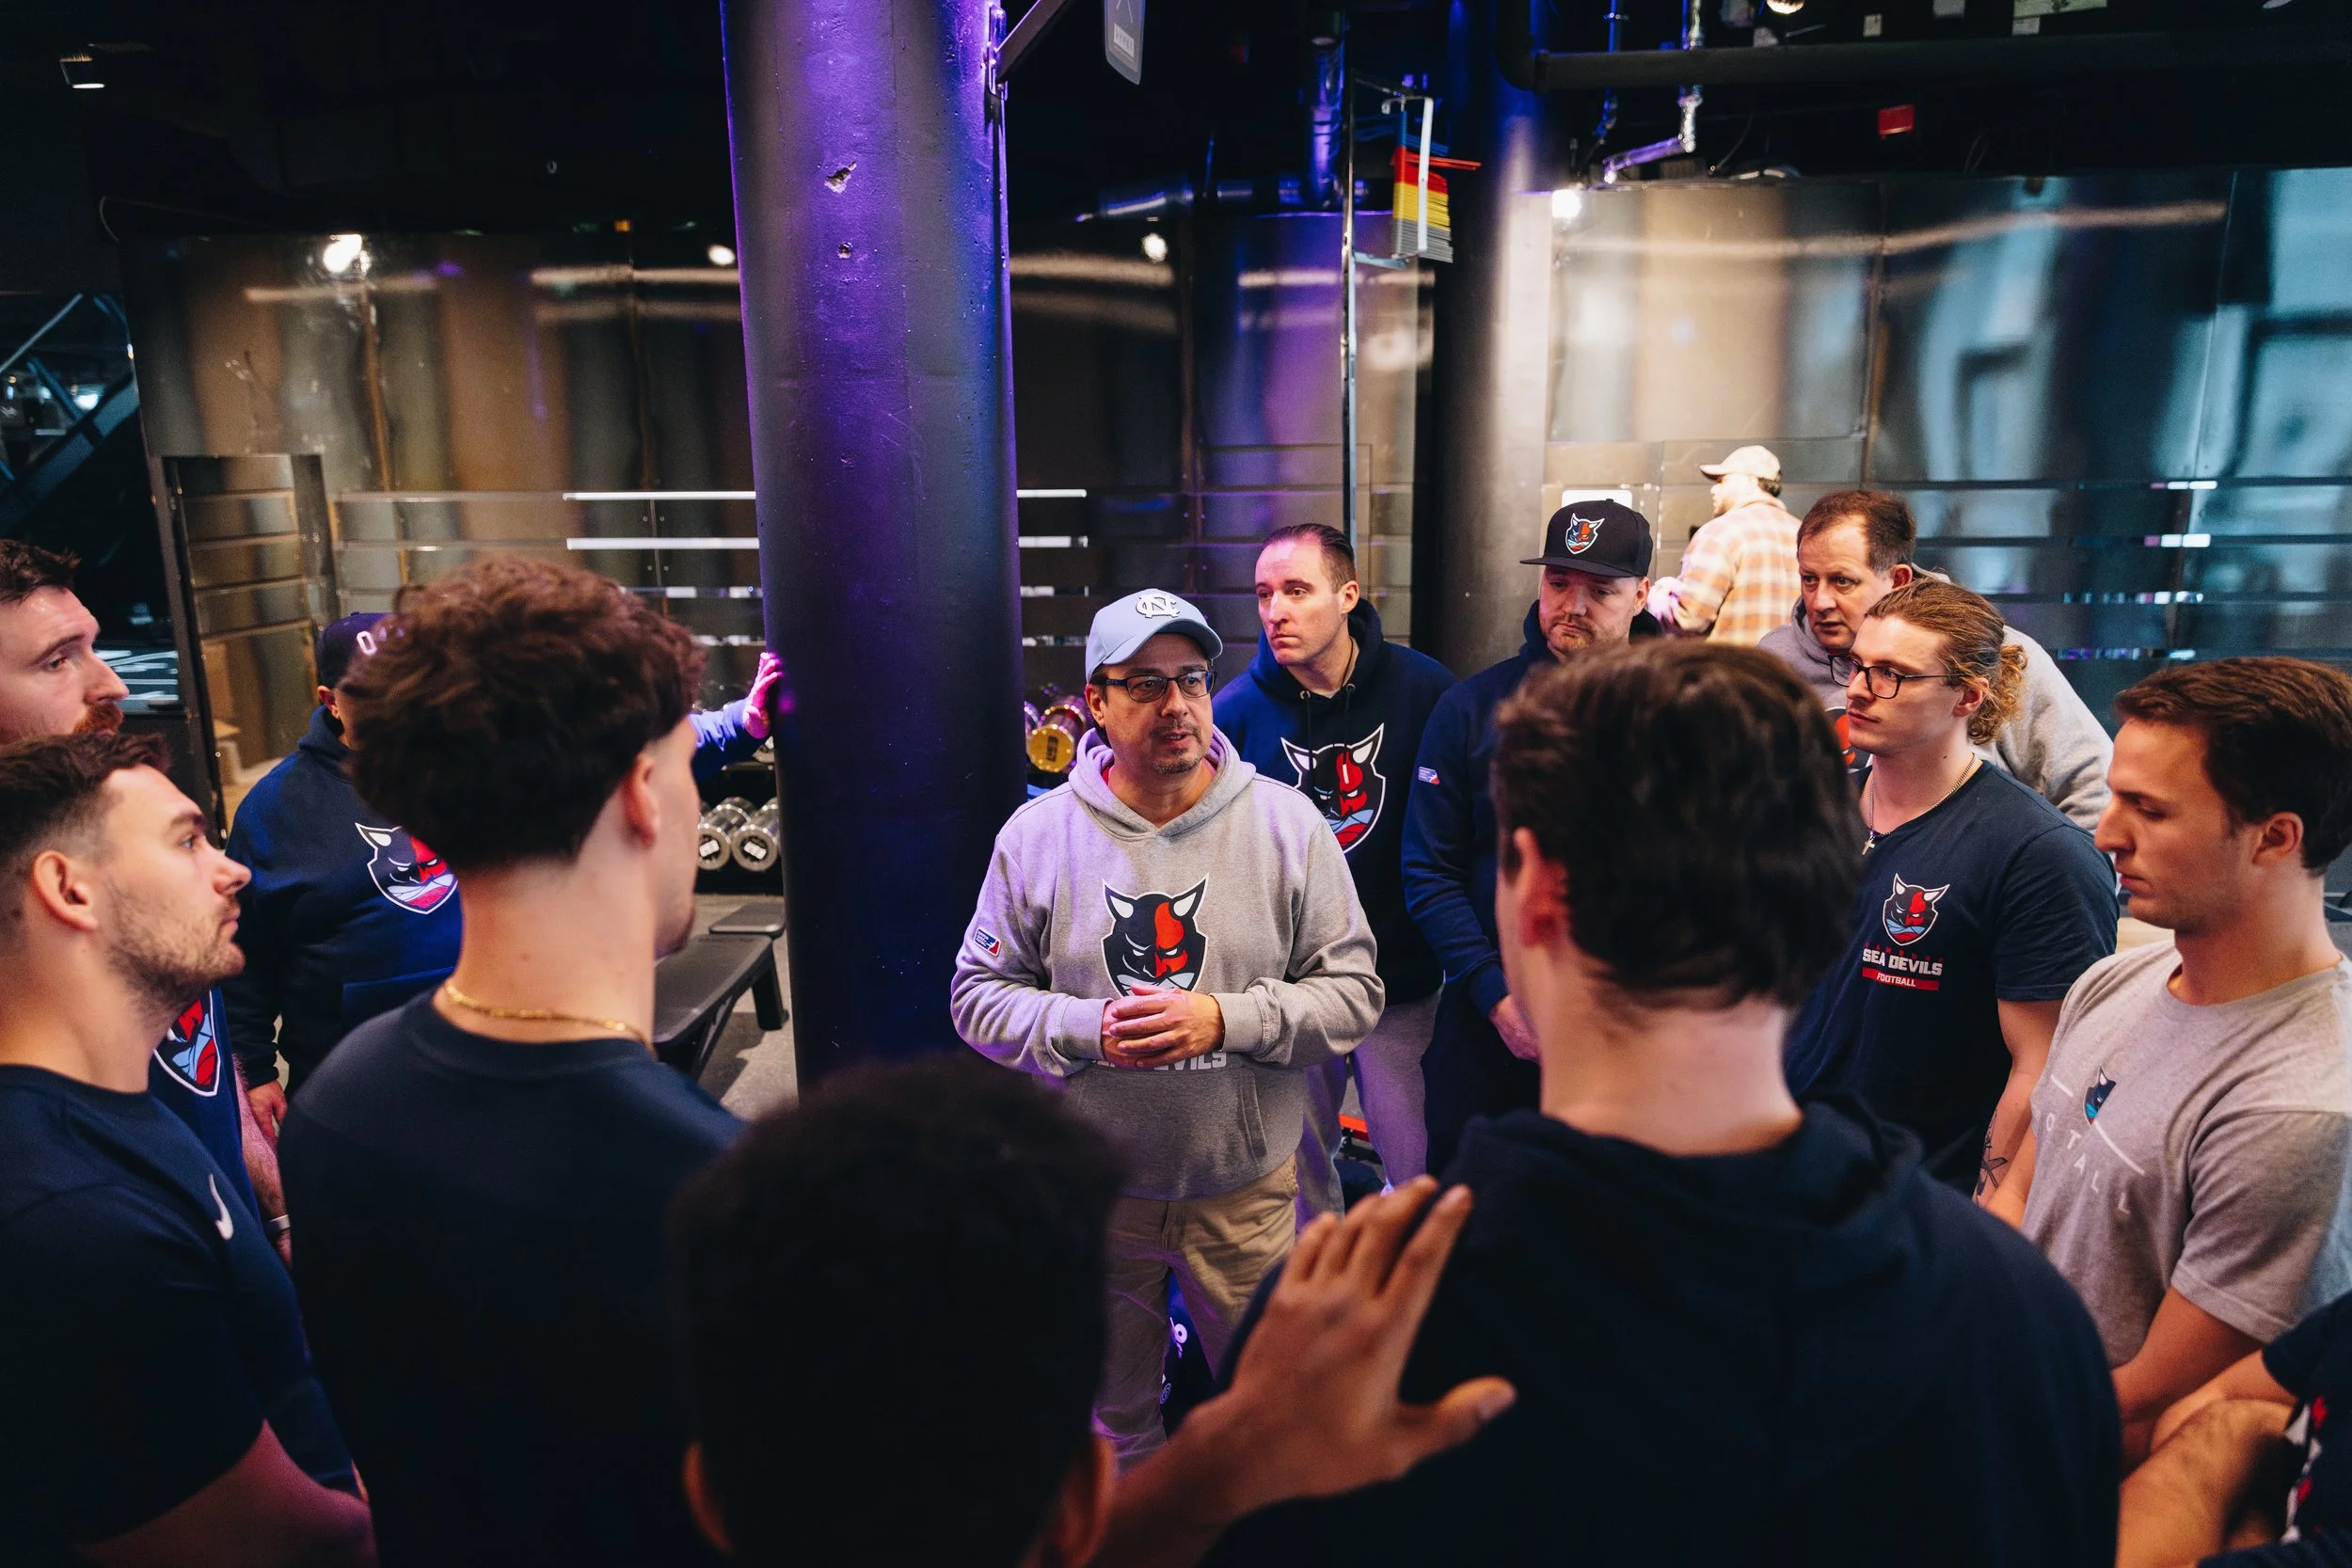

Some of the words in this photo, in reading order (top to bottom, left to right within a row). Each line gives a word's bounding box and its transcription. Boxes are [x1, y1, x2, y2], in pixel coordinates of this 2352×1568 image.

[1863, 948, 1885, 966] SEA
[1888, 955, 1943, 975] DEVILS
[1876, 973, 1915, 987] FOOTBALL
